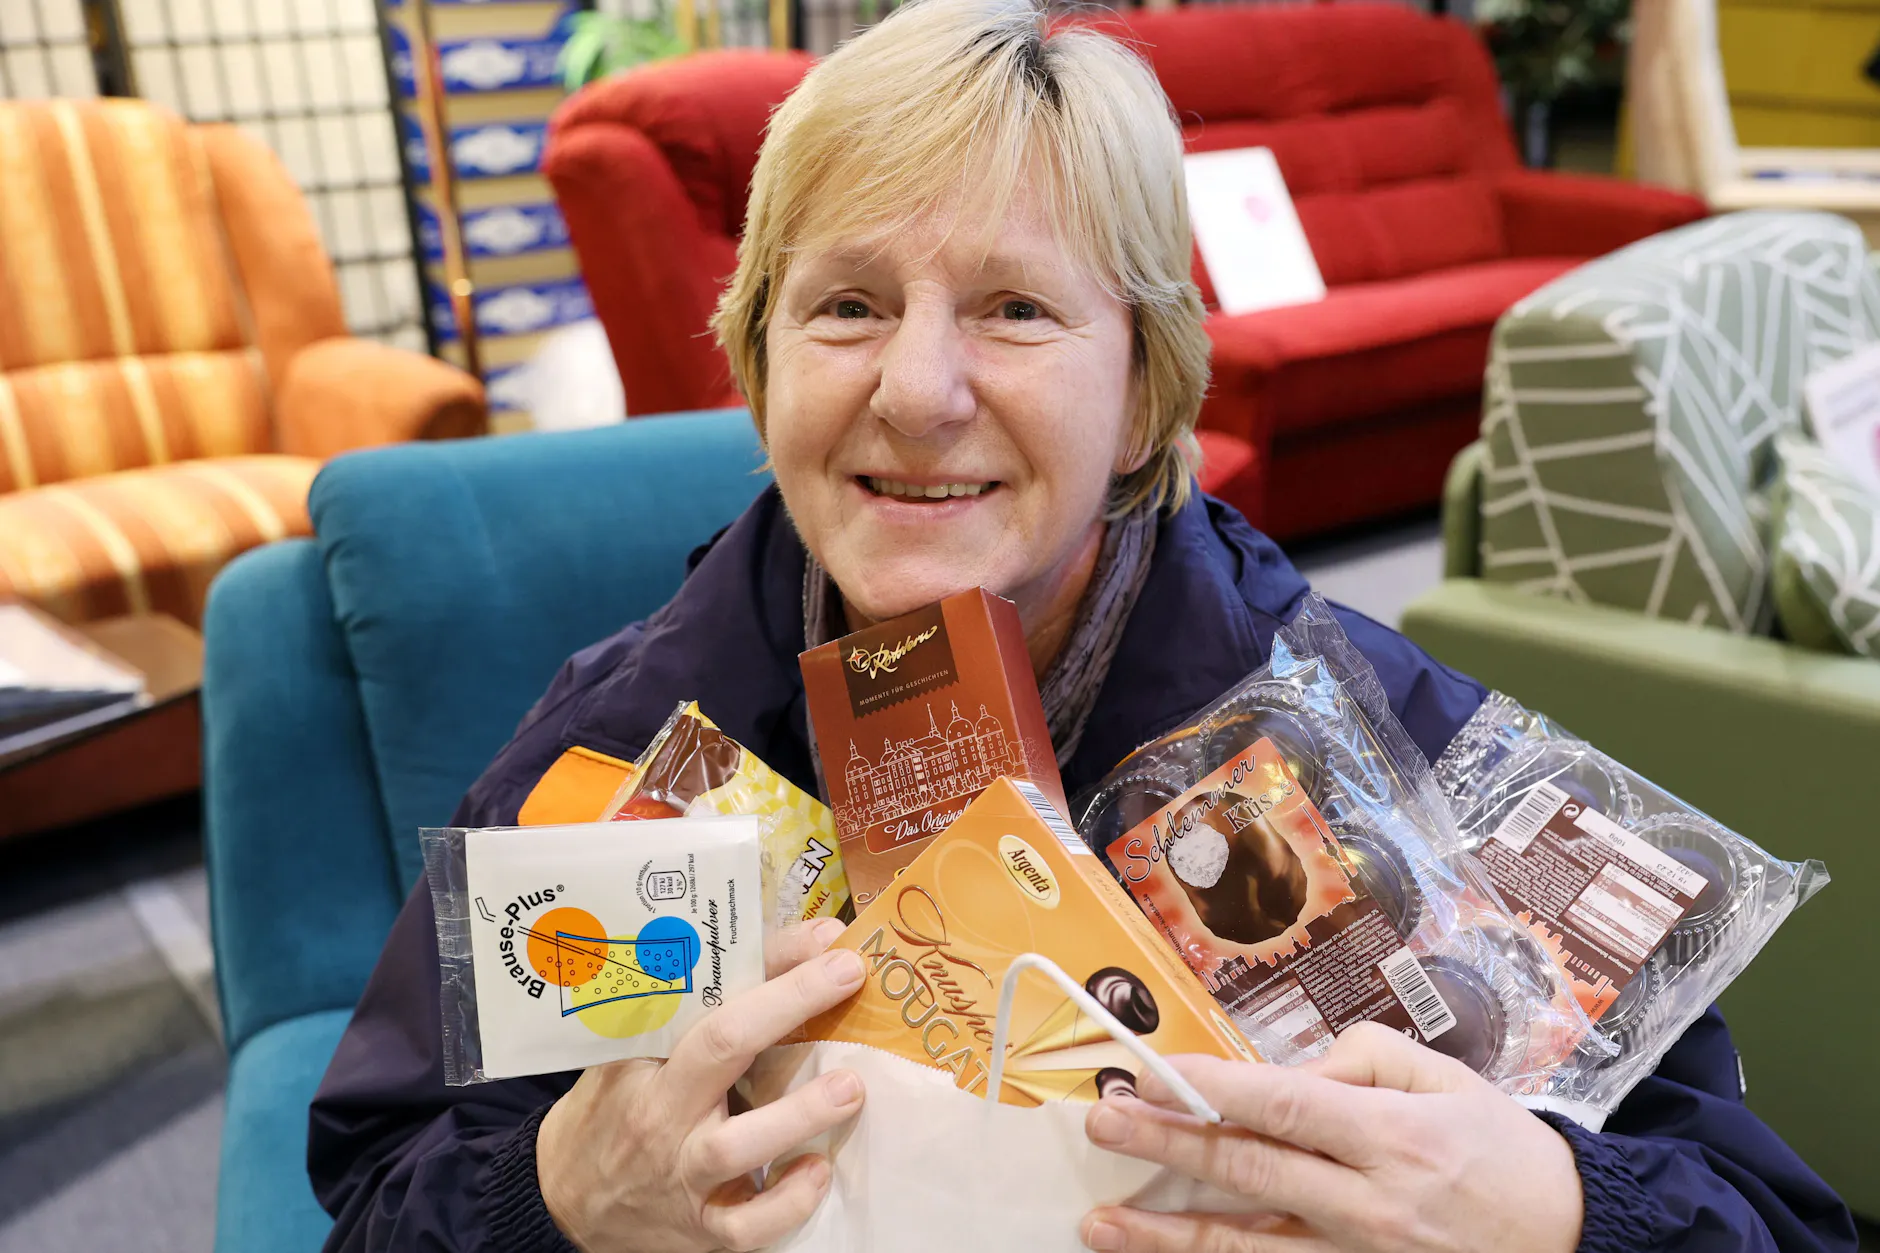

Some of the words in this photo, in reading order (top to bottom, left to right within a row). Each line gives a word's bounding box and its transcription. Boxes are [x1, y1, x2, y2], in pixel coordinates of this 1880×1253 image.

[860, 690, 889, 706] MOMENTE
[891, 685, 904, 694] FÜR
[906, 670, 949, 689] GESCHICHTEN
[884, 819, 920, 841] Das
[1124, 754, 1256, 883] Schlemmer
[1008, 849, 1050, 893] Argenta
[727, 878, 738, 944] Fruchtgeschmack
[702, 898, 726, 1008] Brausepulver
[1387, 972, 1409, 1002] 260096
[1406, 1002, 1428, 1031] 691339
